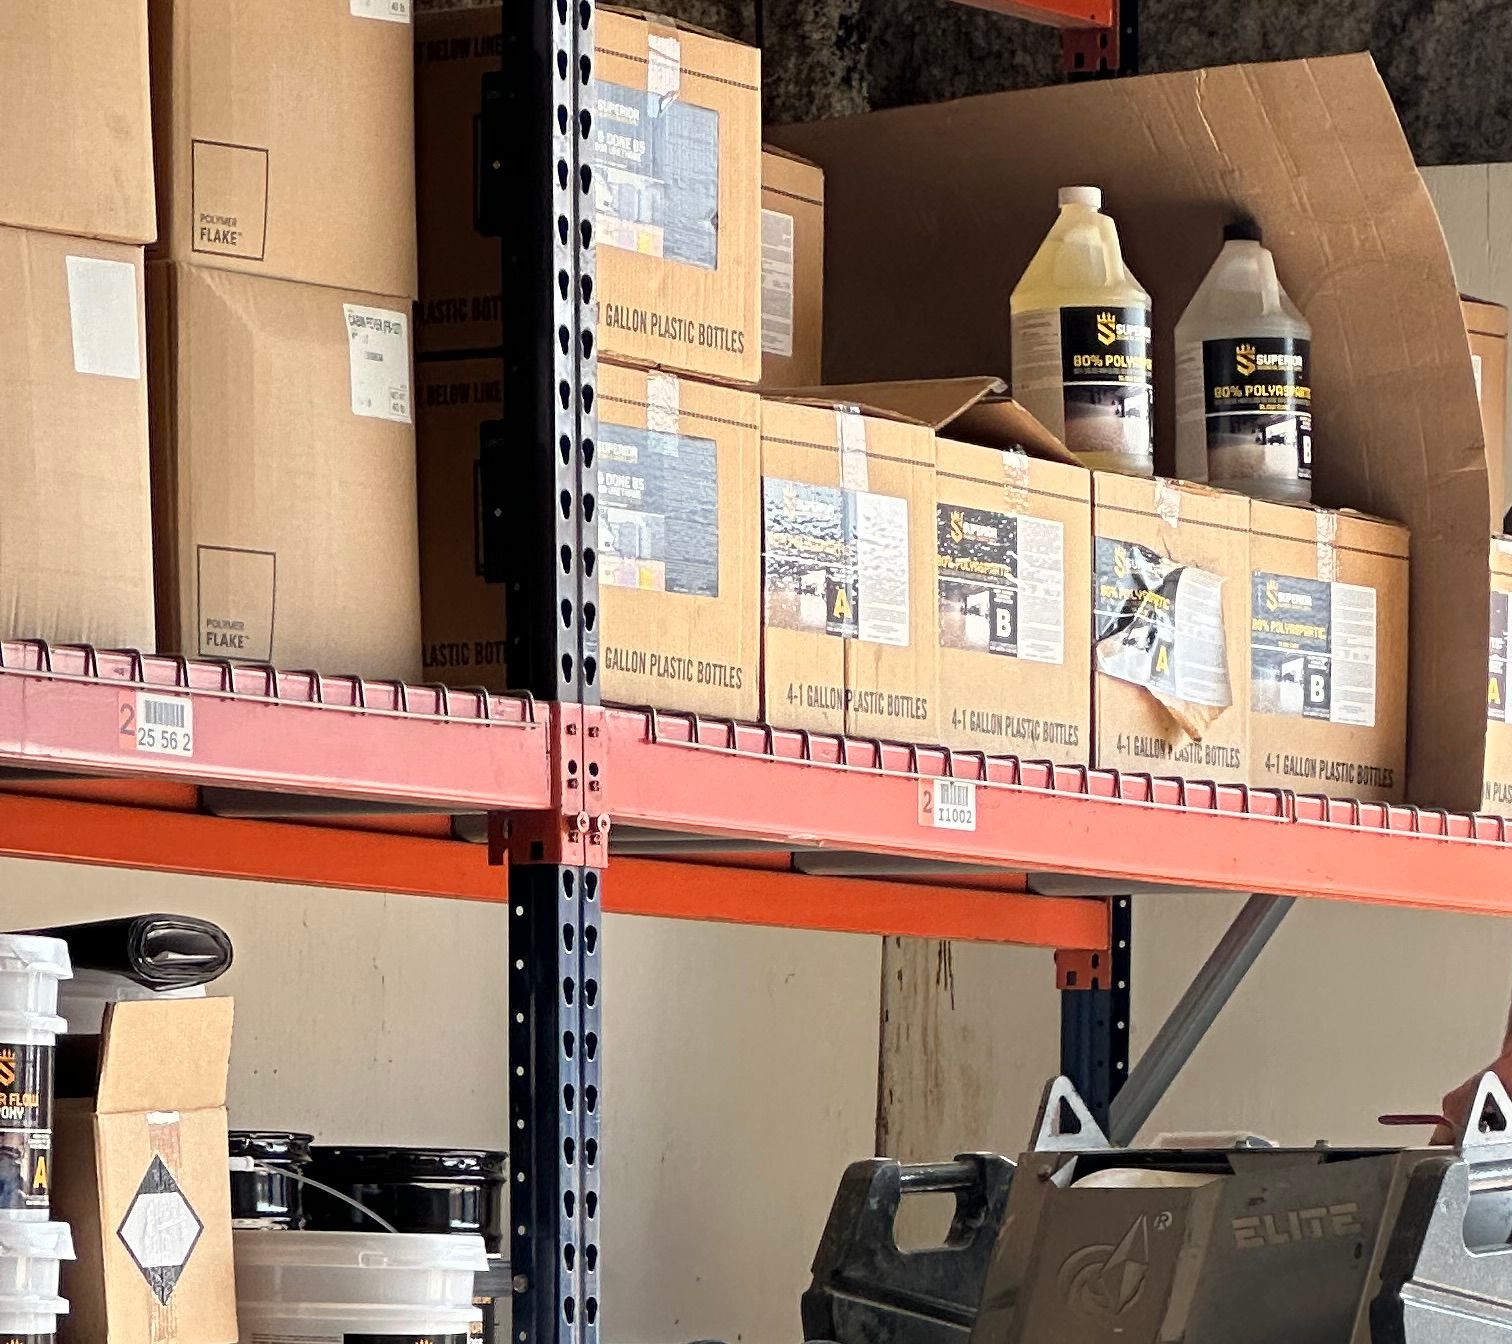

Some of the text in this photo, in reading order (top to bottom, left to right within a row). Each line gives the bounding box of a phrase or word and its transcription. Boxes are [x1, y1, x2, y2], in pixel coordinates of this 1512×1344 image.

[605, 302, 647, 335] GALLON
[650, 311, 695, 344] PLASTIC
[698, 322, 745, 354] BOTTLES
[1073, 354, 1103, 368] 80%
[1256, 353, 1303, 367] SUPERIOR
[1214, 385, 1243, 398] 80%
[832, 587, 853, 619] A
[995, 607, 1012, 638] B
[605, 646, 742, 689] GALLON PLASTIC BOTTLES
[1155, 645, 1169, 673] A
[787, 682, 928, 720] 4-1 GALLON PLASTIC BOTTLES
[1310, 674, 1325, 703] B
[119, 703, 136, 737] 2
[951, 707, 1079, 747] 4-1 GALLON PLASTIC BOTTLES
[137, 727, 191, 752] 25 56 2
[1116, 733, 1131, 755] 4-1
[1133, 735, 1166, 759] GALLON
[1205, 744, 1241, 769] BOTTLES
[1264, 752, 1394, 789] 4-1 GALLON PLASTIC BOTTLES
[922, 789, 932, 814] 2
[9, 1092, 39, 1107] FLOW
[33, 1156, 48, 1189] A
[1231, 1202, 1362, 1249] ELITE
